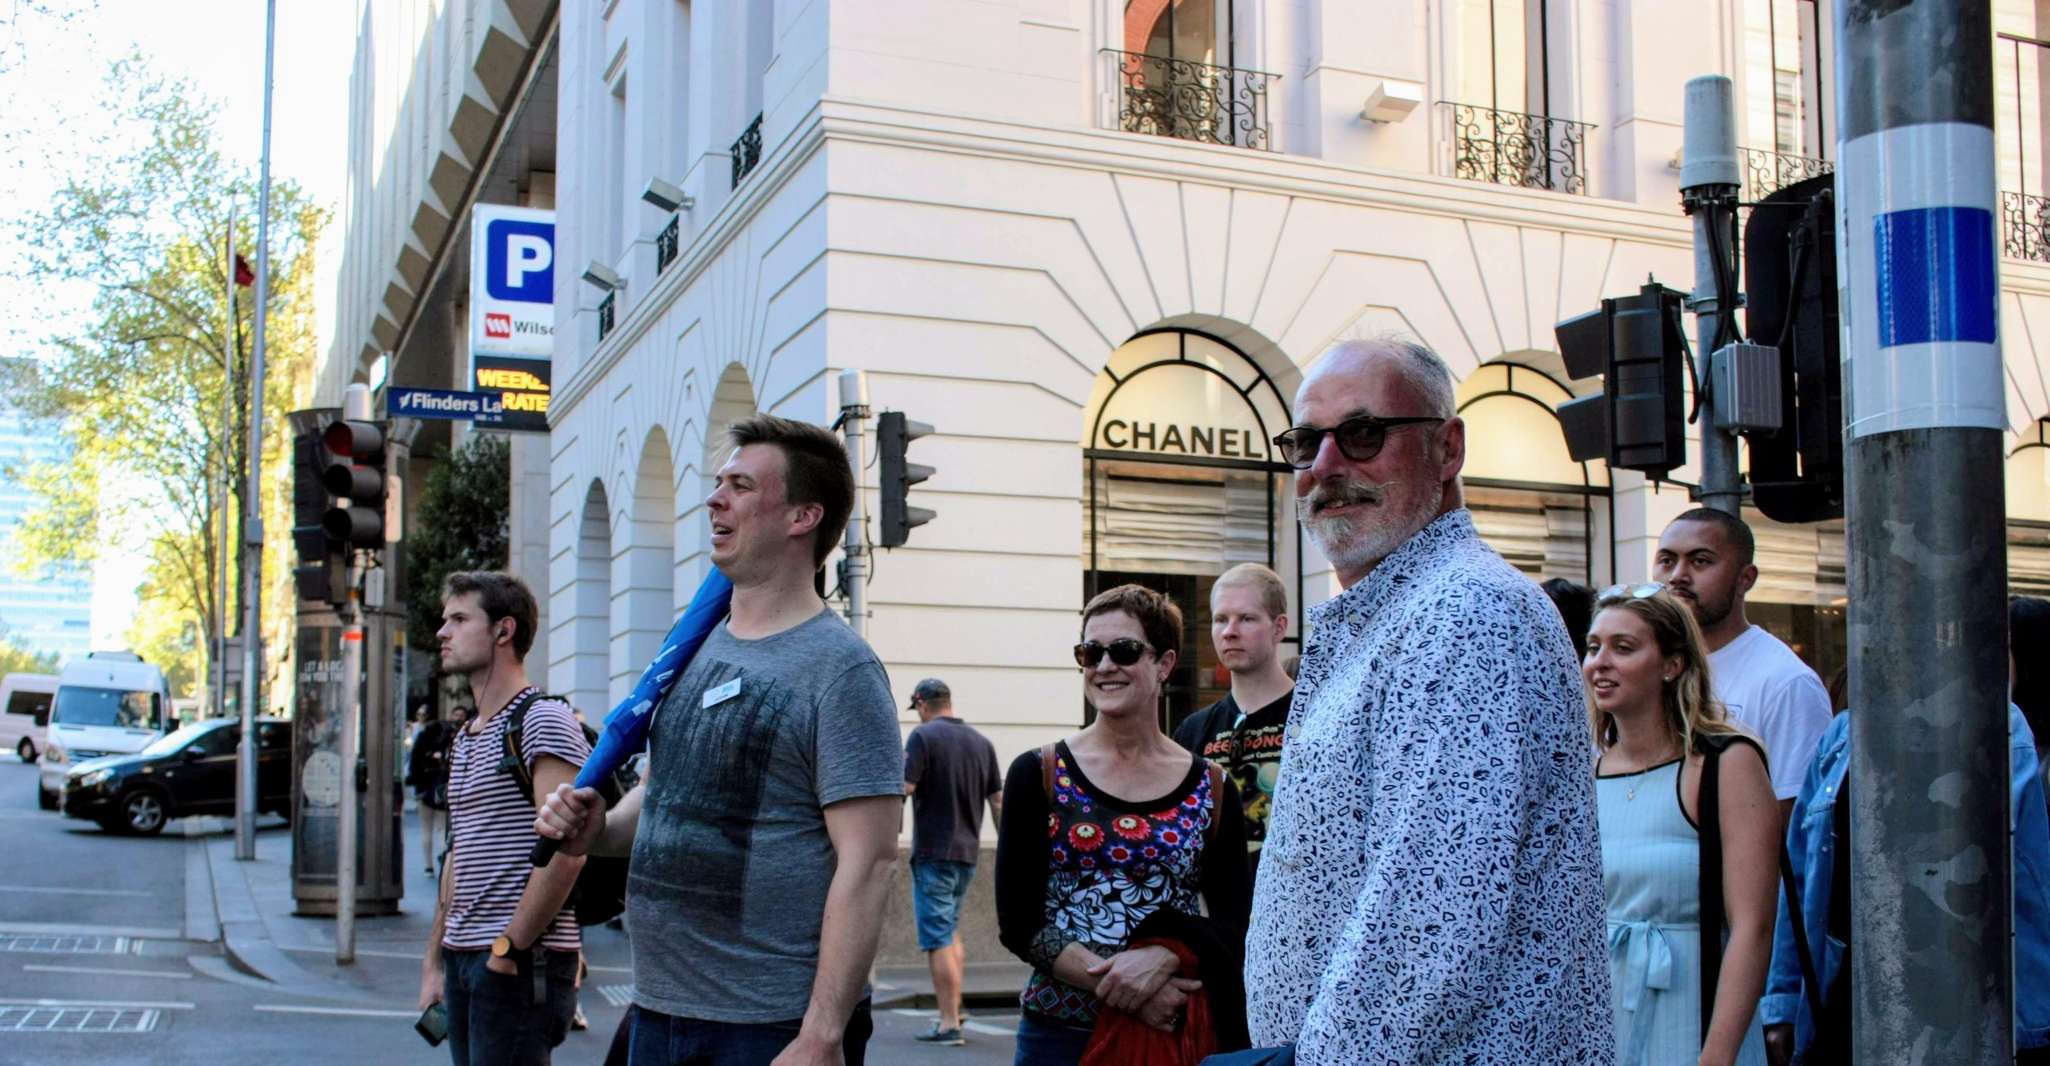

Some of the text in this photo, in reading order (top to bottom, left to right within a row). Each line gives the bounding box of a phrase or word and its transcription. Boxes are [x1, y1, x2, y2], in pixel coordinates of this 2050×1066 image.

[506, 233, 552, 288] P
[412, 392, 503, 413] Flinders La
[1103, 419, 1263, 459] CHANEL
[1203, 739, 1234, 755] BEE
